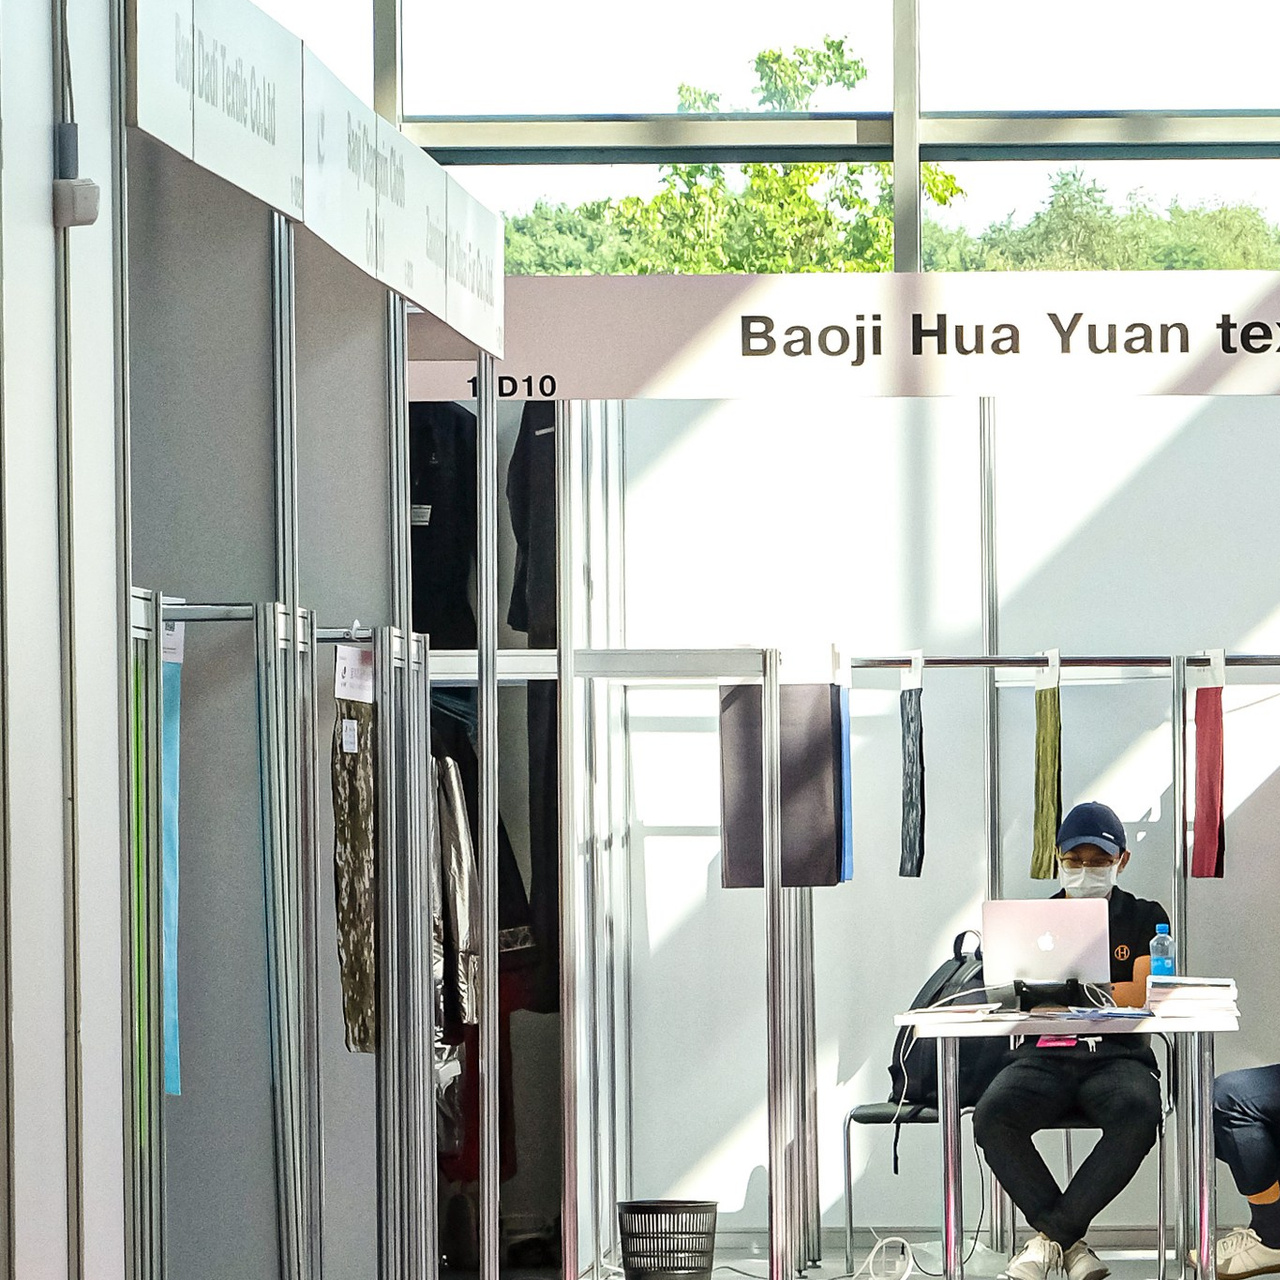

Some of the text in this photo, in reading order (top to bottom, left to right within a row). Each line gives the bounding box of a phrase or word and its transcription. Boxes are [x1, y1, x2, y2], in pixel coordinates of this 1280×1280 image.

[175, 11, 194, 111] Baoj
[740, 313, 882, 367] Baoji
[911, 313, 1020, 356] Hua
[1047, 312, 1189, 354] Yuan
[467, 375, 556, 398] 1D10
